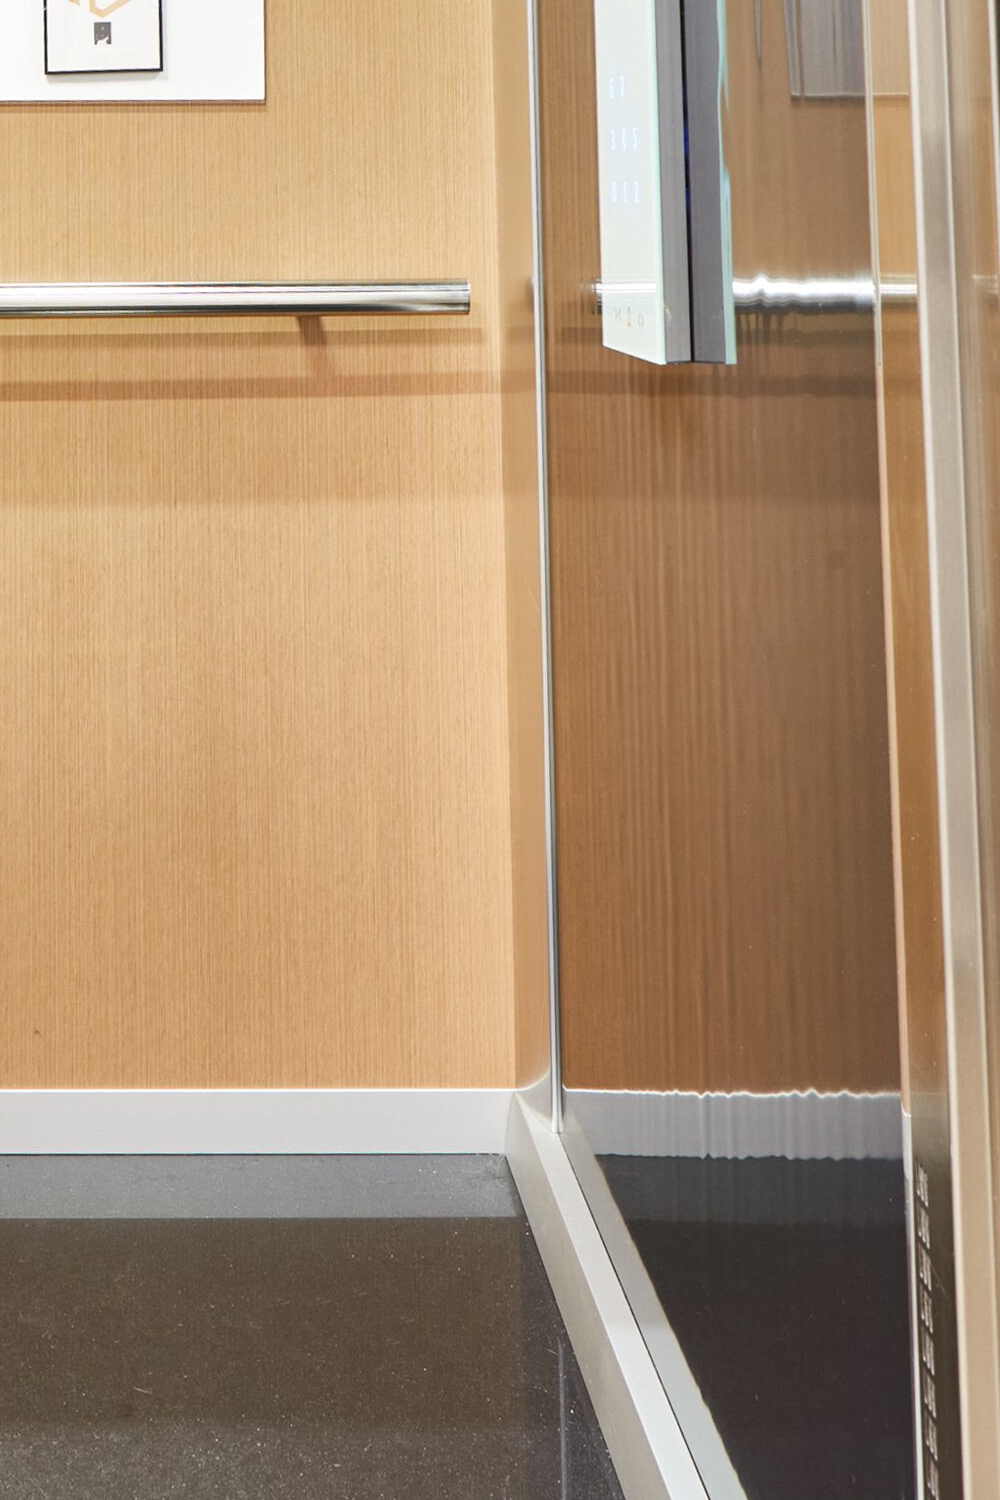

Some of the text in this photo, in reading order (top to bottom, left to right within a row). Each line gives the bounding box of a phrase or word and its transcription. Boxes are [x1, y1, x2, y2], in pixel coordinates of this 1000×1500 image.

[608, 75, 625, 100] 6 7
[610, 126, 639, 151] 3 4 5
[623, 180, 628, 203] 1
[634, 180, 640, 203] 2
